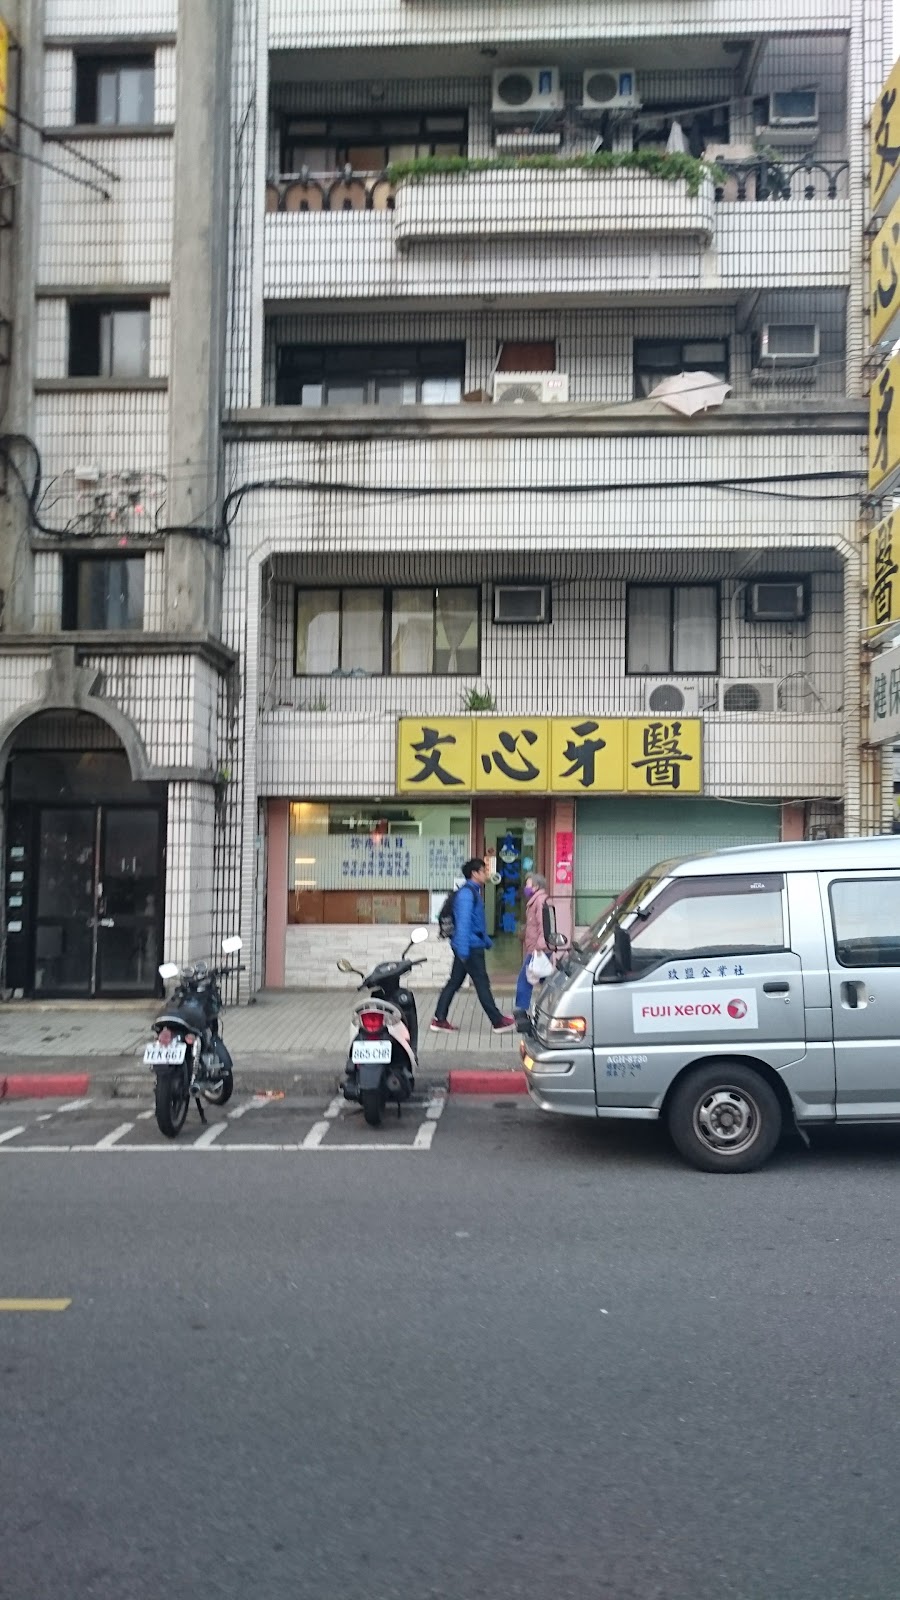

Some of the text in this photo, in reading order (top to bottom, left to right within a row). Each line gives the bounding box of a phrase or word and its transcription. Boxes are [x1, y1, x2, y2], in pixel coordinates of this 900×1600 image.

[872, 87, 900, 626] 文心牙醫
[406, 721, 693, 790] 文心牙醫
[641, 1006, 671, 1017] FUJI
